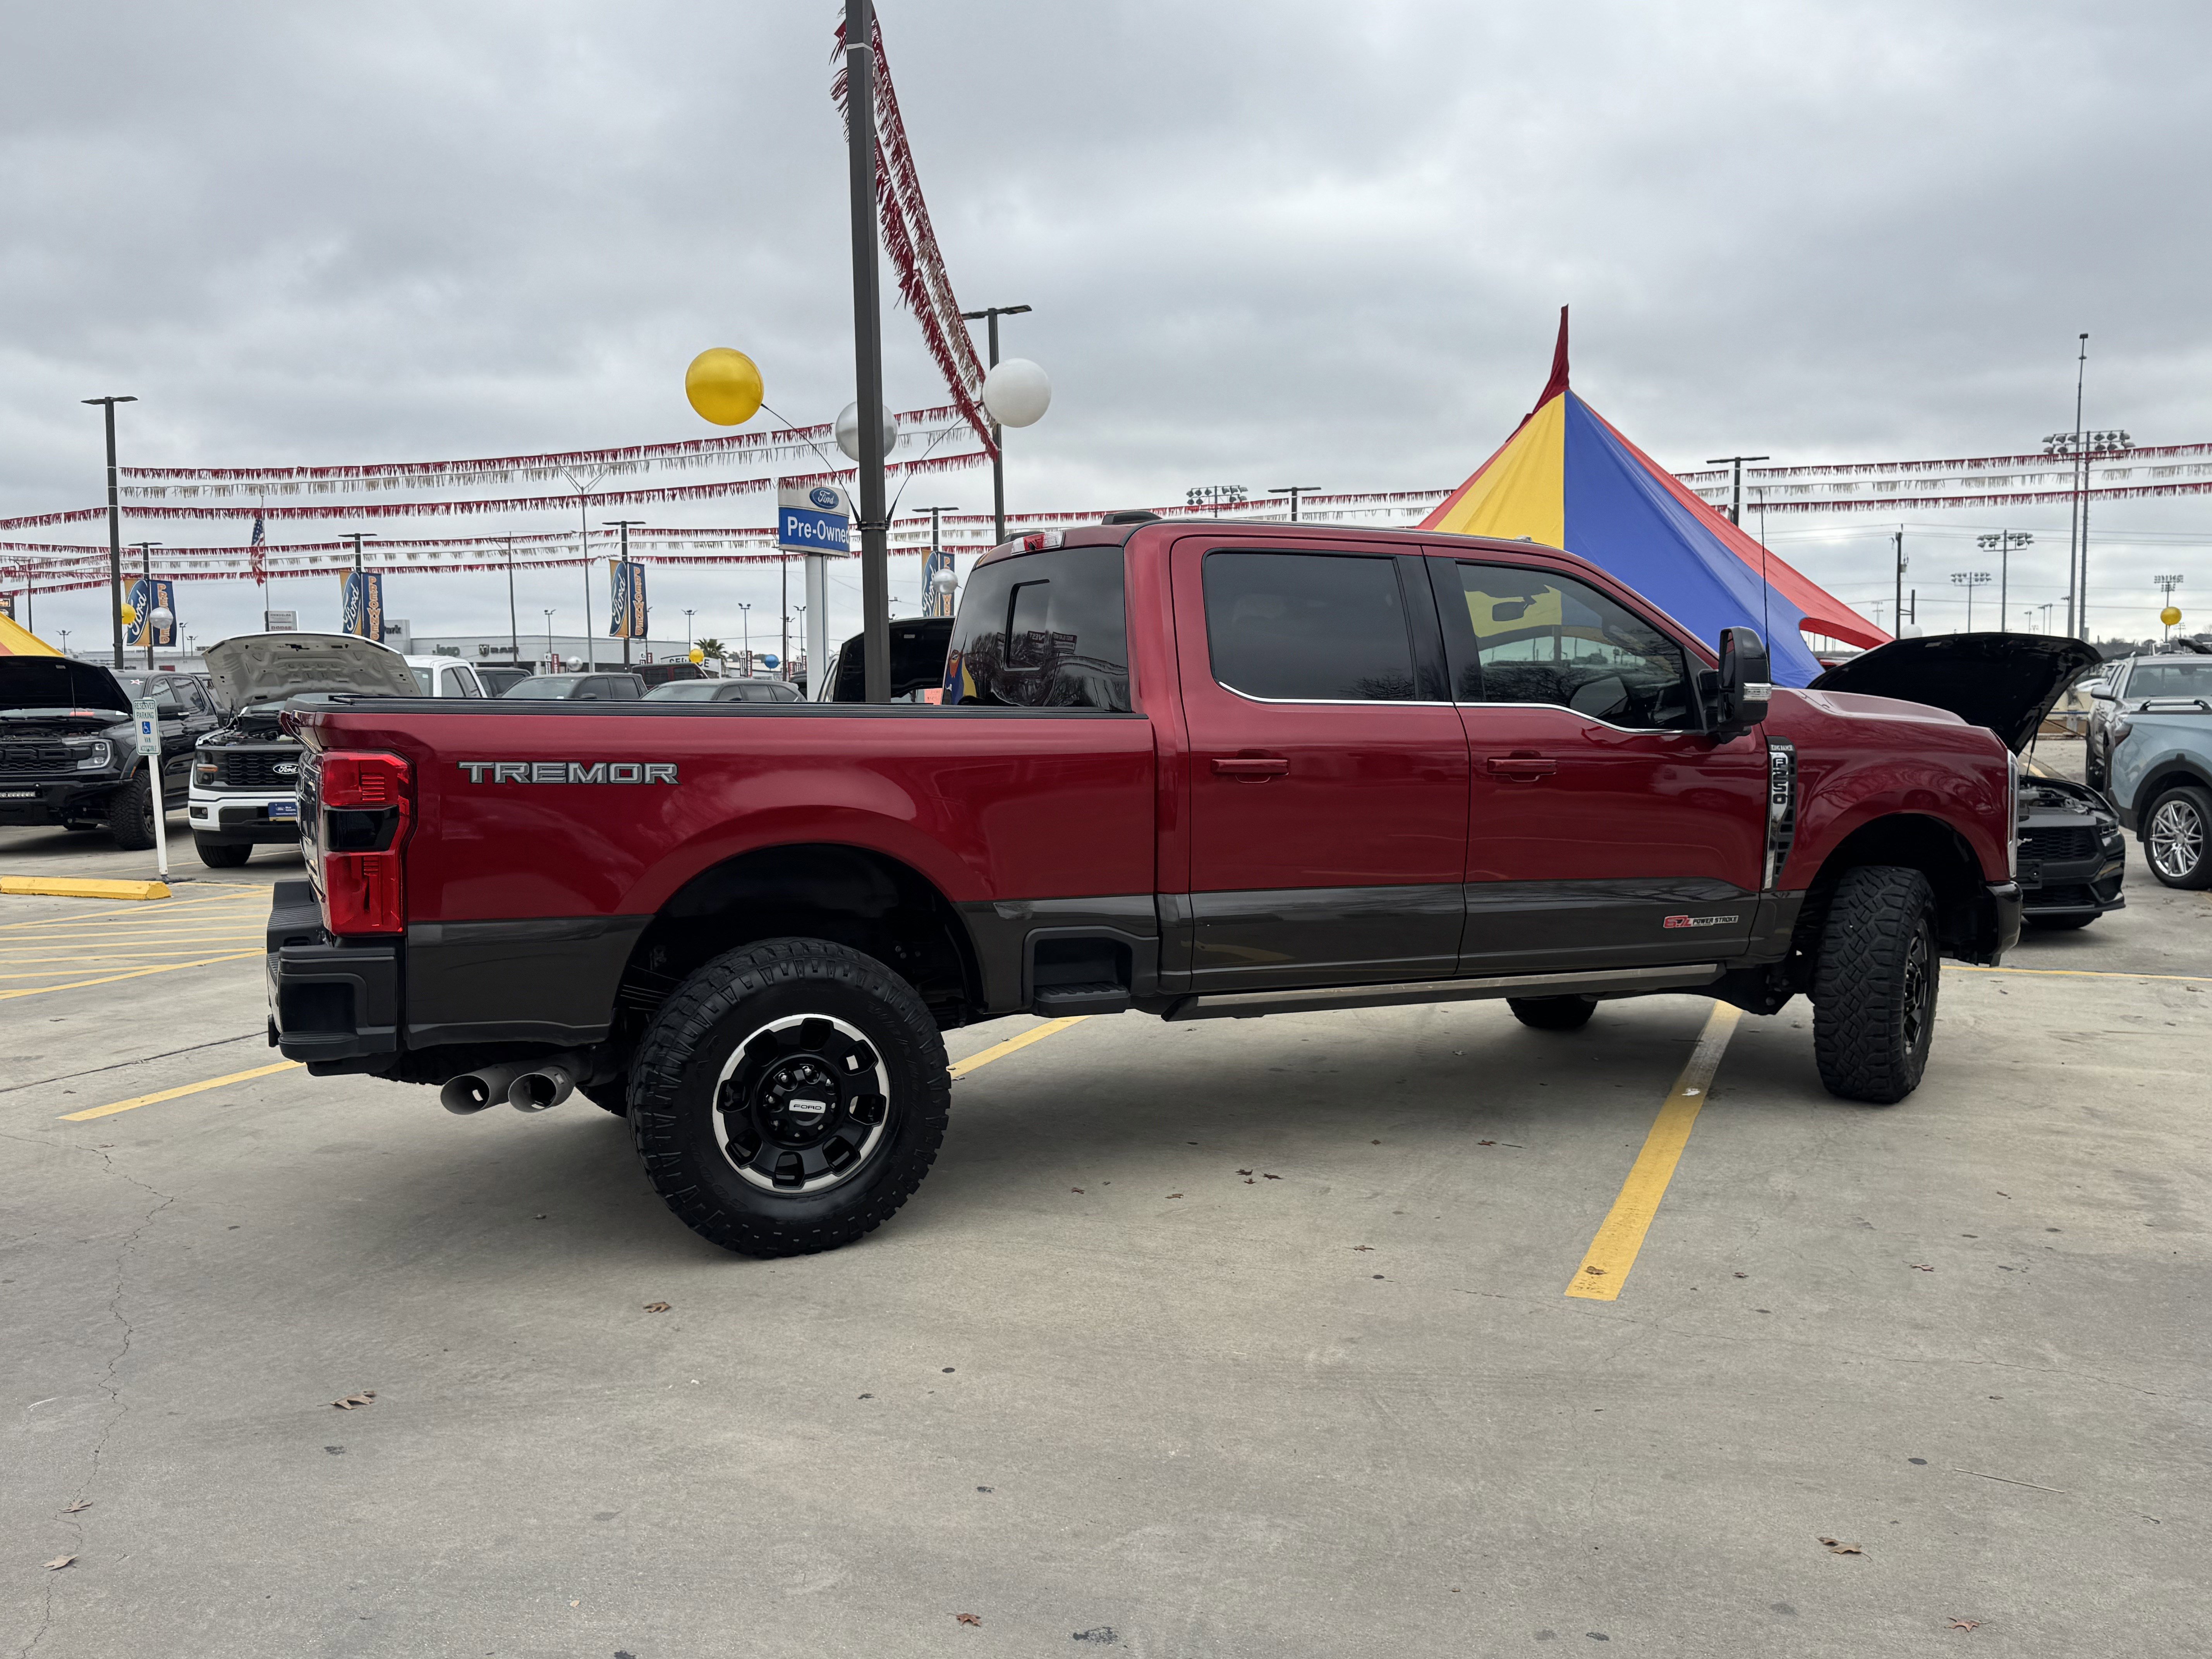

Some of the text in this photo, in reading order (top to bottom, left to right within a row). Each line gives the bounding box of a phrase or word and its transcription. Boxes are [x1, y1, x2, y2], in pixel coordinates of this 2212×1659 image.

[818, 490, 834, 504] Ford
[157, 583, 170, 644] PREED
[343, 582, 359, 631] Ford
[367, 576, 381, 640] PREOWNED
[612, 573, 626, 625] Ford
[632, 567, 644, 636] PREOWNED
[457, 761, 681, 785] TREMOR
